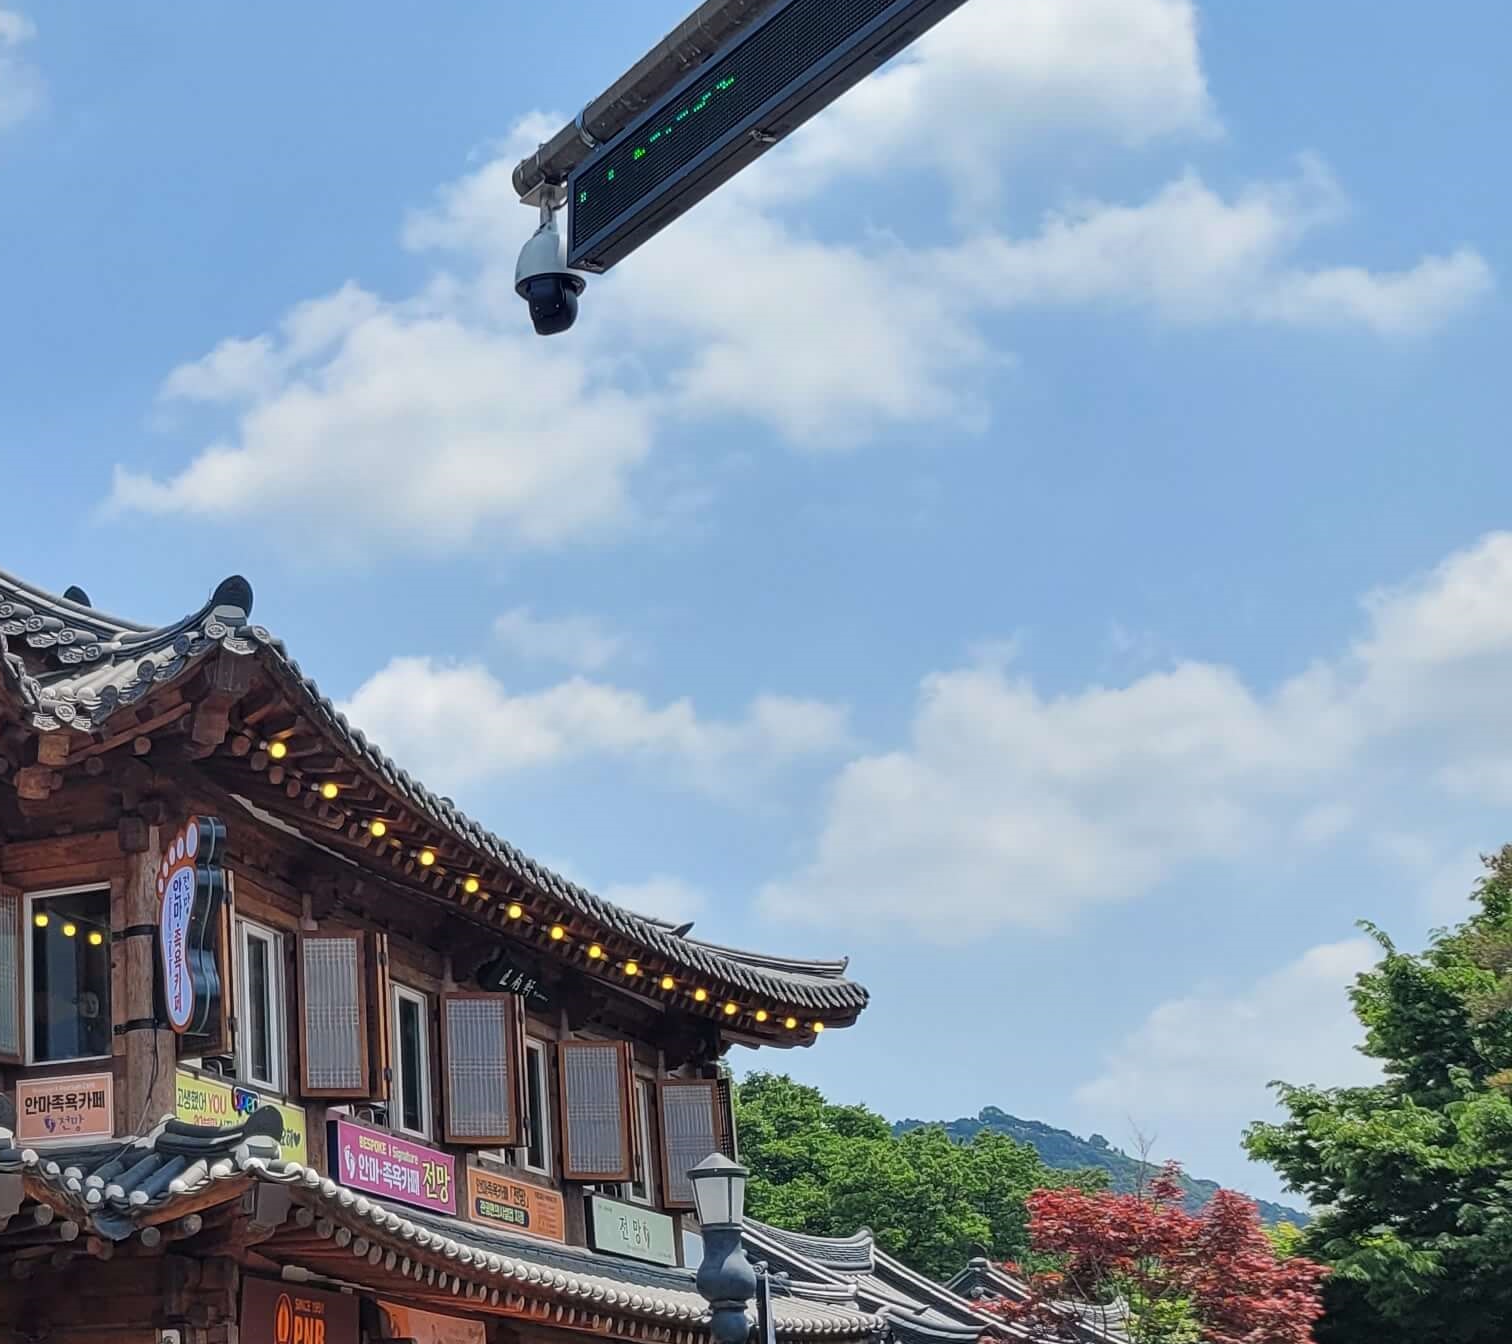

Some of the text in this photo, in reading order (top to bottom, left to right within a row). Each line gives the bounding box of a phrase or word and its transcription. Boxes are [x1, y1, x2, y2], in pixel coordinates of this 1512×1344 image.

[24, 1089, 106, 1116] 안마족욕카페
[208, 1092, 227, 1115] YOU
[56, 1114, 85, 1133] 전망
[358, 1135, 387, 1156] BESPOKE
[421, 1159, 451, 1204] 전망
[618, 1215, 642, 1245] 전망
